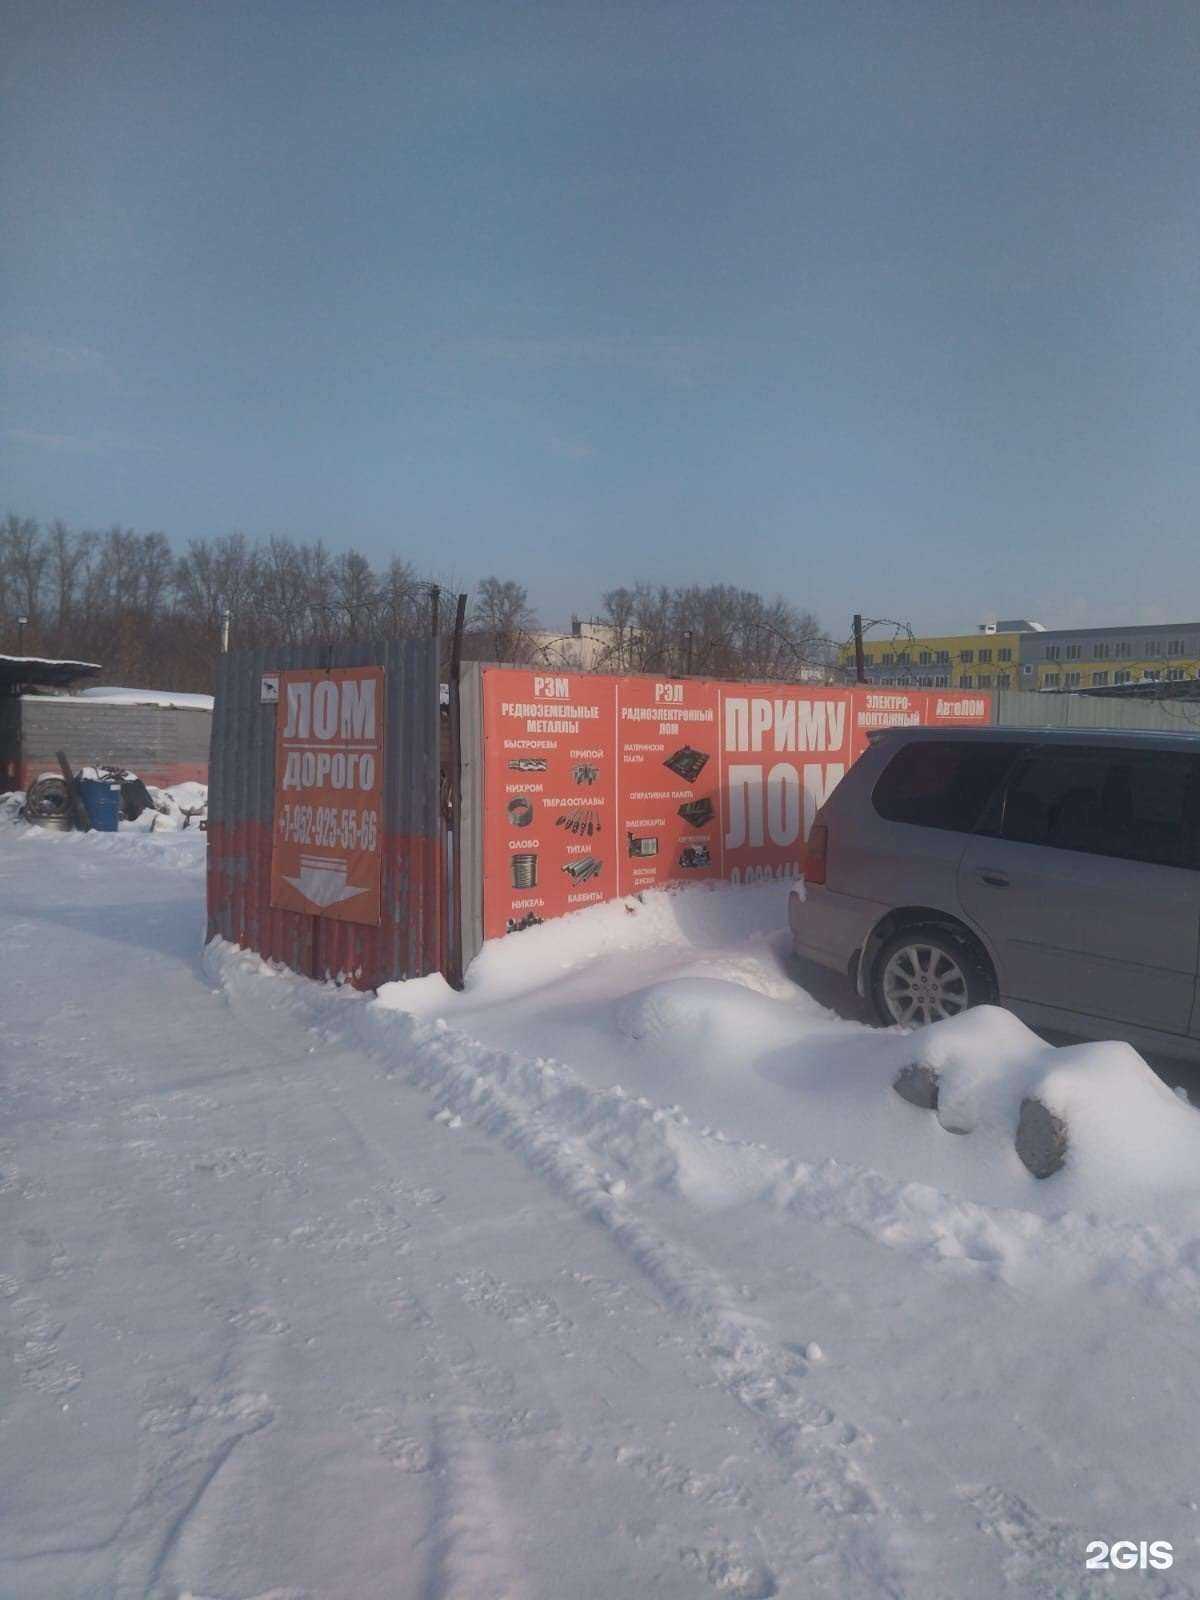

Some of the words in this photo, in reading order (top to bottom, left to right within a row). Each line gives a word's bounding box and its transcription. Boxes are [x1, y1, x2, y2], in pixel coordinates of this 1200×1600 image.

[284, 679, 376, 739] ЛОМ
[866, 695, 911, 709] ЭЛЕКТРО-
[502, 703, 600, 719] РЕДКОЗЕМЕЛЬНЫЕ
[857, 710, 920, 726] МОНТАЖНЫЙ
[527, 720, 579, 733] МЕТАЛЛЫ
[725, 697, 846, 752] ПРИМУ
[570, 750, 604, 758] ПРИПОЙ
[283, 753, 375, 791] ДОРОГО
[505, 784, 544, 793] НИХРОМ
[725, 762, 845, 849] ЛОМ
[508, 840, 540, 849] ОЛОВО
[566, 845, 592, 854] ТИТАН
[511, 899, 545, 910] НИКЕЛЬ
